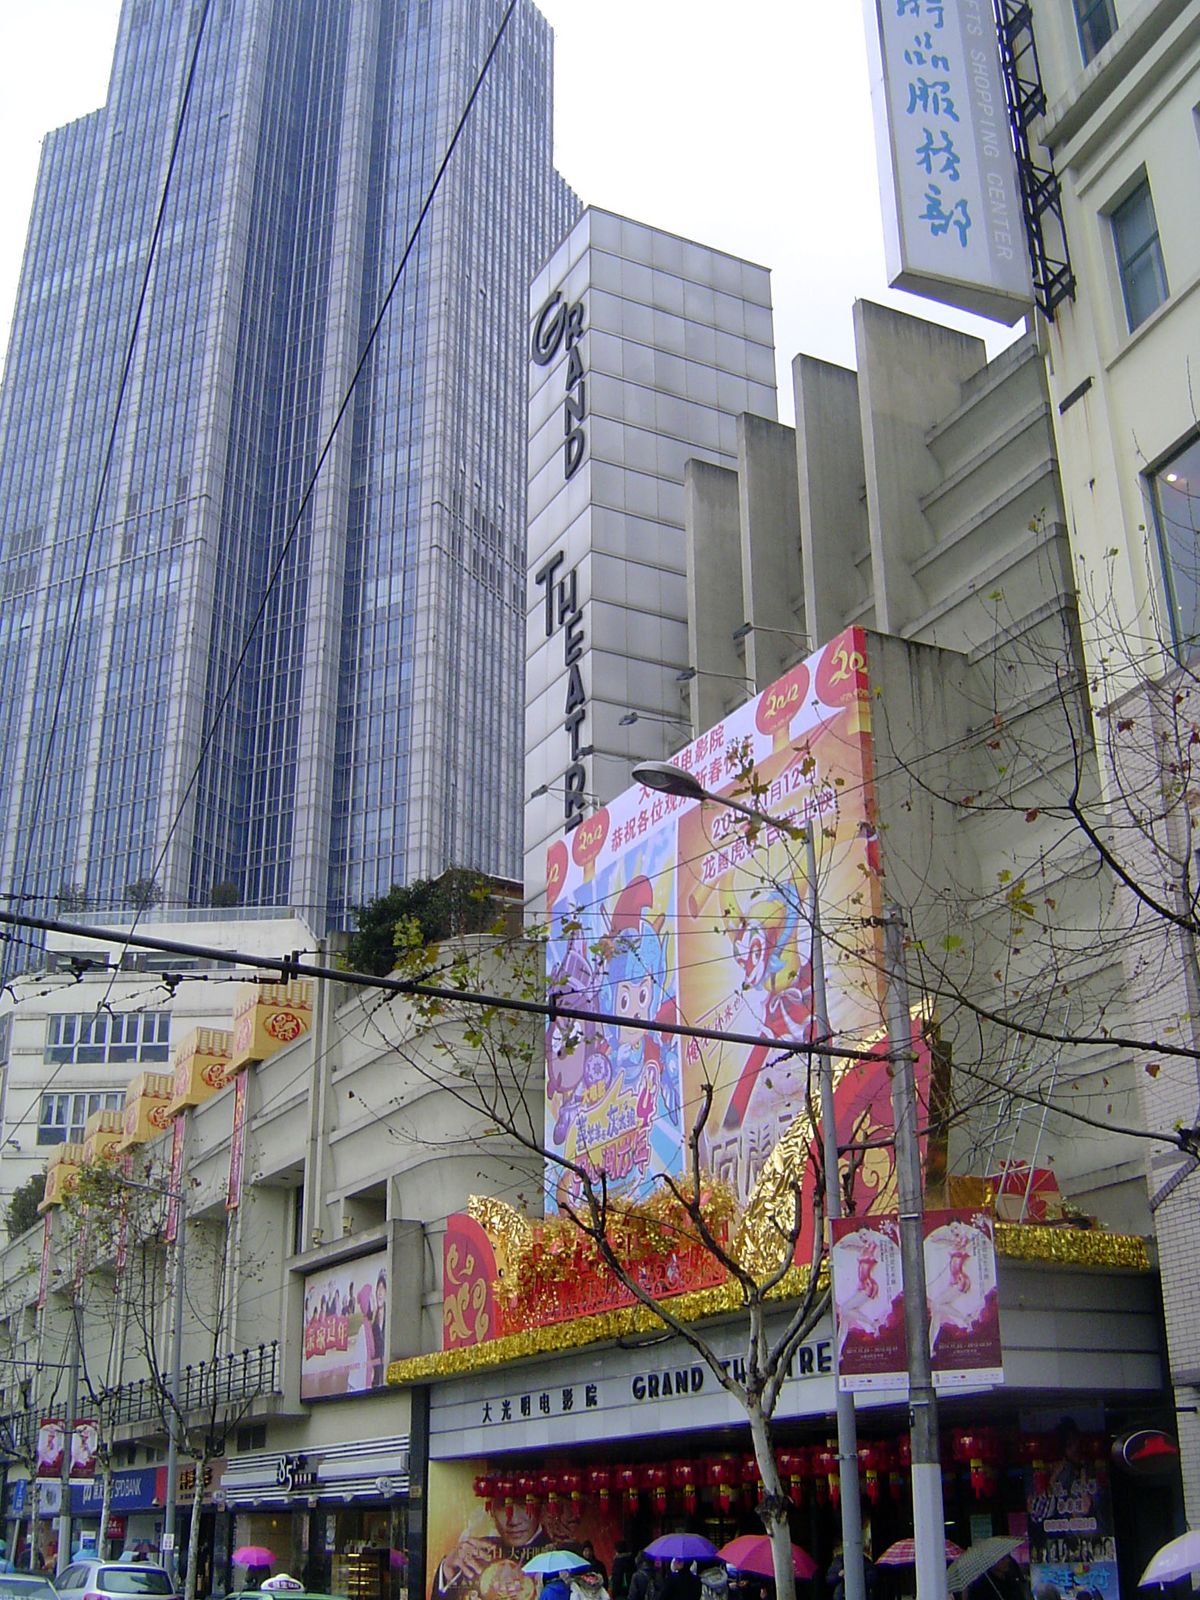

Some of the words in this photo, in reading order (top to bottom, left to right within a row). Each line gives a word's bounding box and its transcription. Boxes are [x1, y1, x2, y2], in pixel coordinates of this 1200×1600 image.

[970, 48, 1000, 158] SHOPPING
[986, 172, 1013, 261] CENTER
[531, 290, 585, 480] GRAND
[535, 550, 586, 835] THEATR
[482, 1384, 598, 1423] 大光明电影院
[632, 1366, 704, 1400] GRAND
